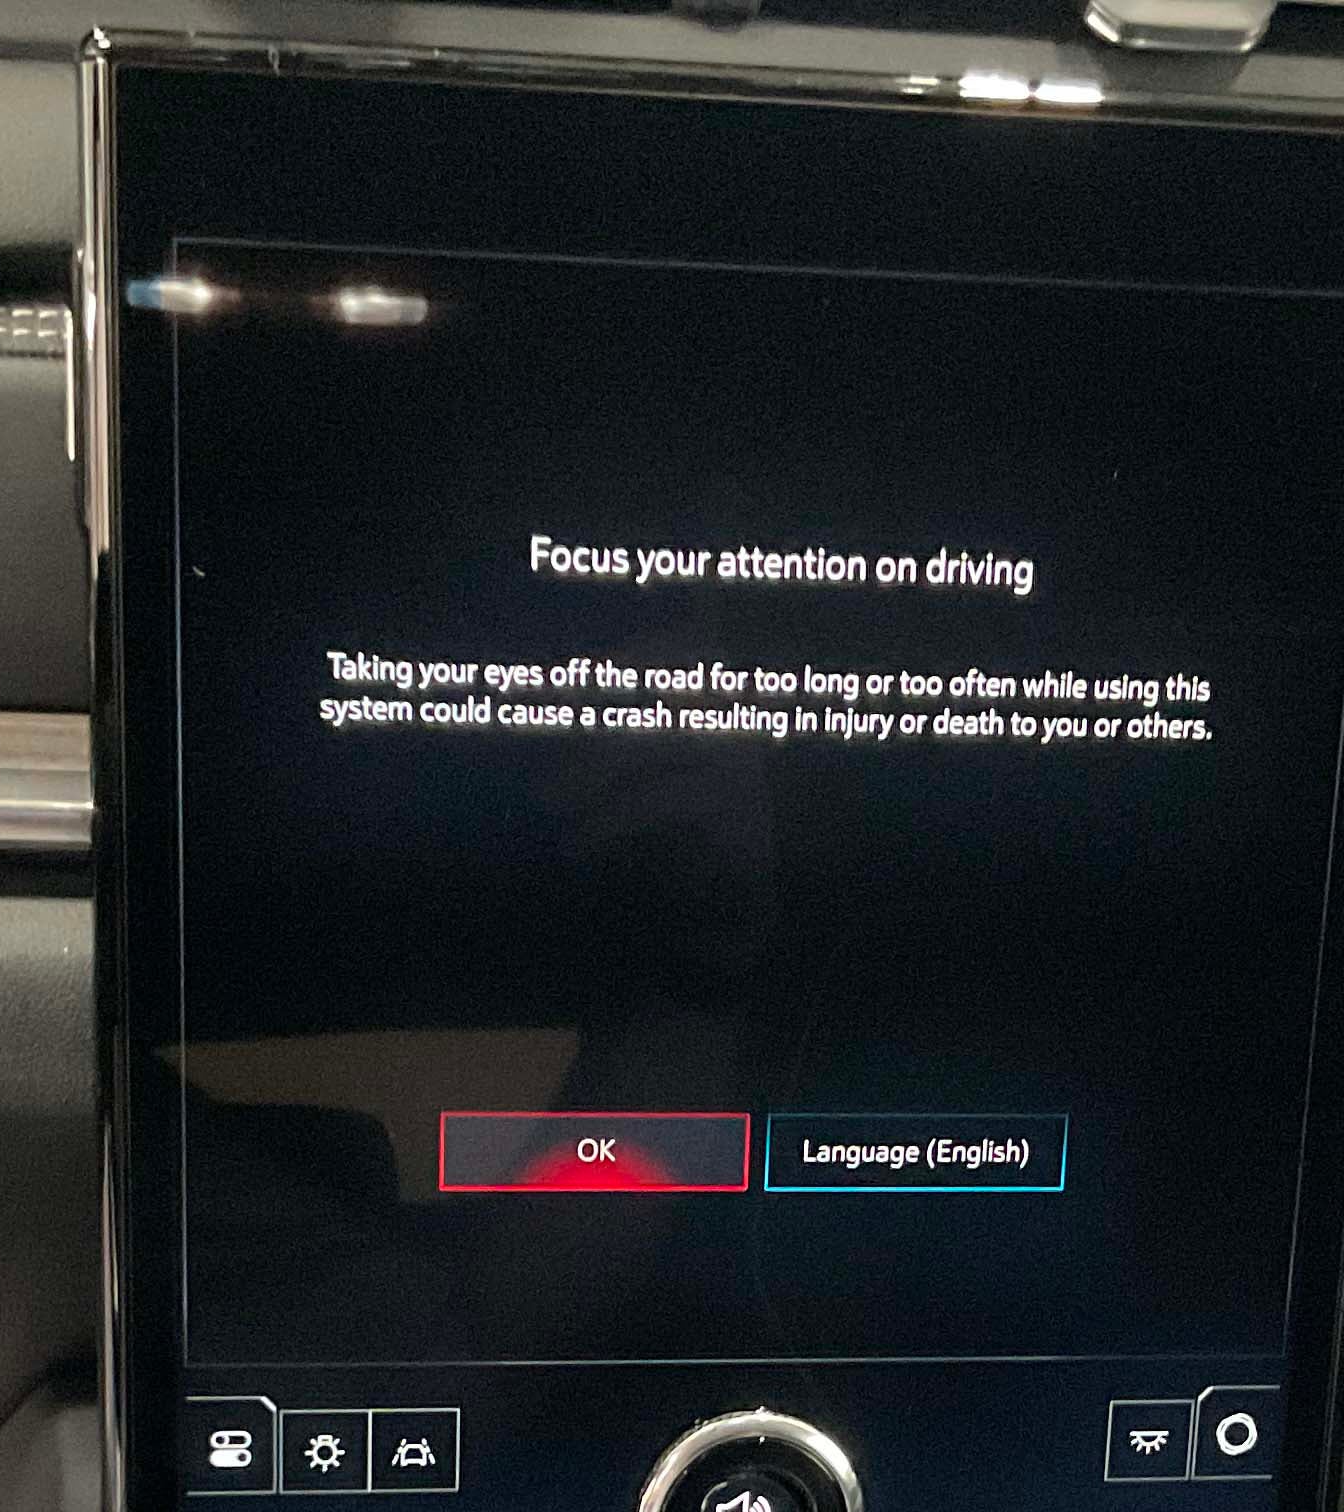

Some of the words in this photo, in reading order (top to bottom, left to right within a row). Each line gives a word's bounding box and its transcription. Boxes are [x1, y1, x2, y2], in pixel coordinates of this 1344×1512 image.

[529, 534, 630, 575] Focus
[635, 547, 712, 584] your
[716, 545, 867, 582] attention
[875, 553, 917, 583] on
[926, 547, 1034, 596] driving
[326, 651, 414, 689] Taking
[417, 662, 479, 690] your
[484, 664, 543, 692] eyes
[549, 657, 592, 688] off
[594, 660, 638, 689] the
[644, 662, 704, 690] road
[709, 661, 749, 691] for
[754, 666, 798, 692] too
[803, 664, 859, 700] long
[865, 671, 895, 695] or
[899, 669, 943, 696] too
[949, 667, 1017, 698] often
[1022, 668, 1086, 699] while
[1093, 674, 1159, 708] using
[1165, 672, 1211, 702] this
[319, 696, 413, 728] system
[419, 695, 491, 725] could
[497, 702, 574, 726] cause
[579, 703, 597, 728] a
[602, 700, 672, 729] crash
[678, 701, 788, 739] resulting
[795, 706, 817, 732] in
[824, 706, 895, 740] injury
[899, 711, 928, 734] or
[933, 706, 1005, 735] death
[1010, 710, 1037, 737] to
[1041, 714, 1088, 744] you
[1093, 715, 1122, 738] or
[1127, 713, 1213, 741] others.
[577, 1138, 616, 1162] OK
[802, 1138, 922, 1170] Language
[926, 1138, 1030, 1169] (English)
